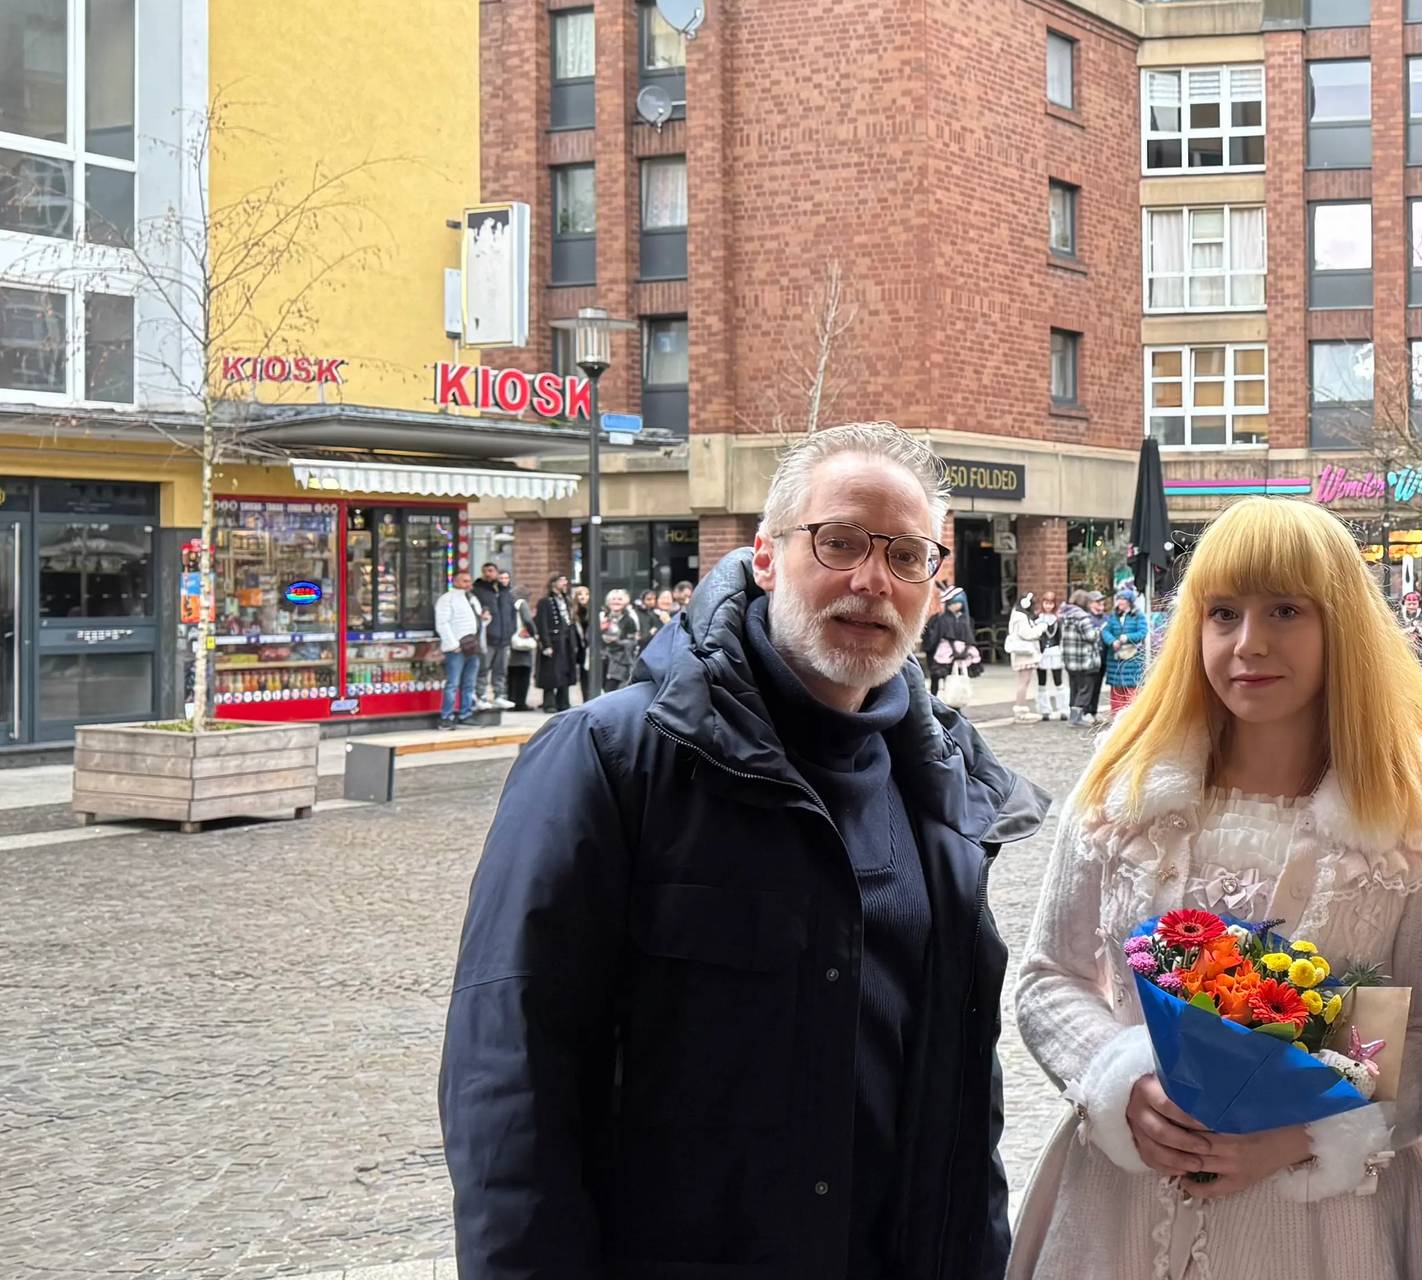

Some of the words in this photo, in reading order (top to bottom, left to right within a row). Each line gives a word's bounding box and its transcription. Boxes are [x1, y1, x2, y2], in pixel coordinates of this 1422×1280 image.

[222, 356, 343, 384] KIOSK
[437, 361, 591, 419] KIOSK
[970, 467, 1018, 491] FOLDED
[1316, 463, 1386, 504] Wonder
